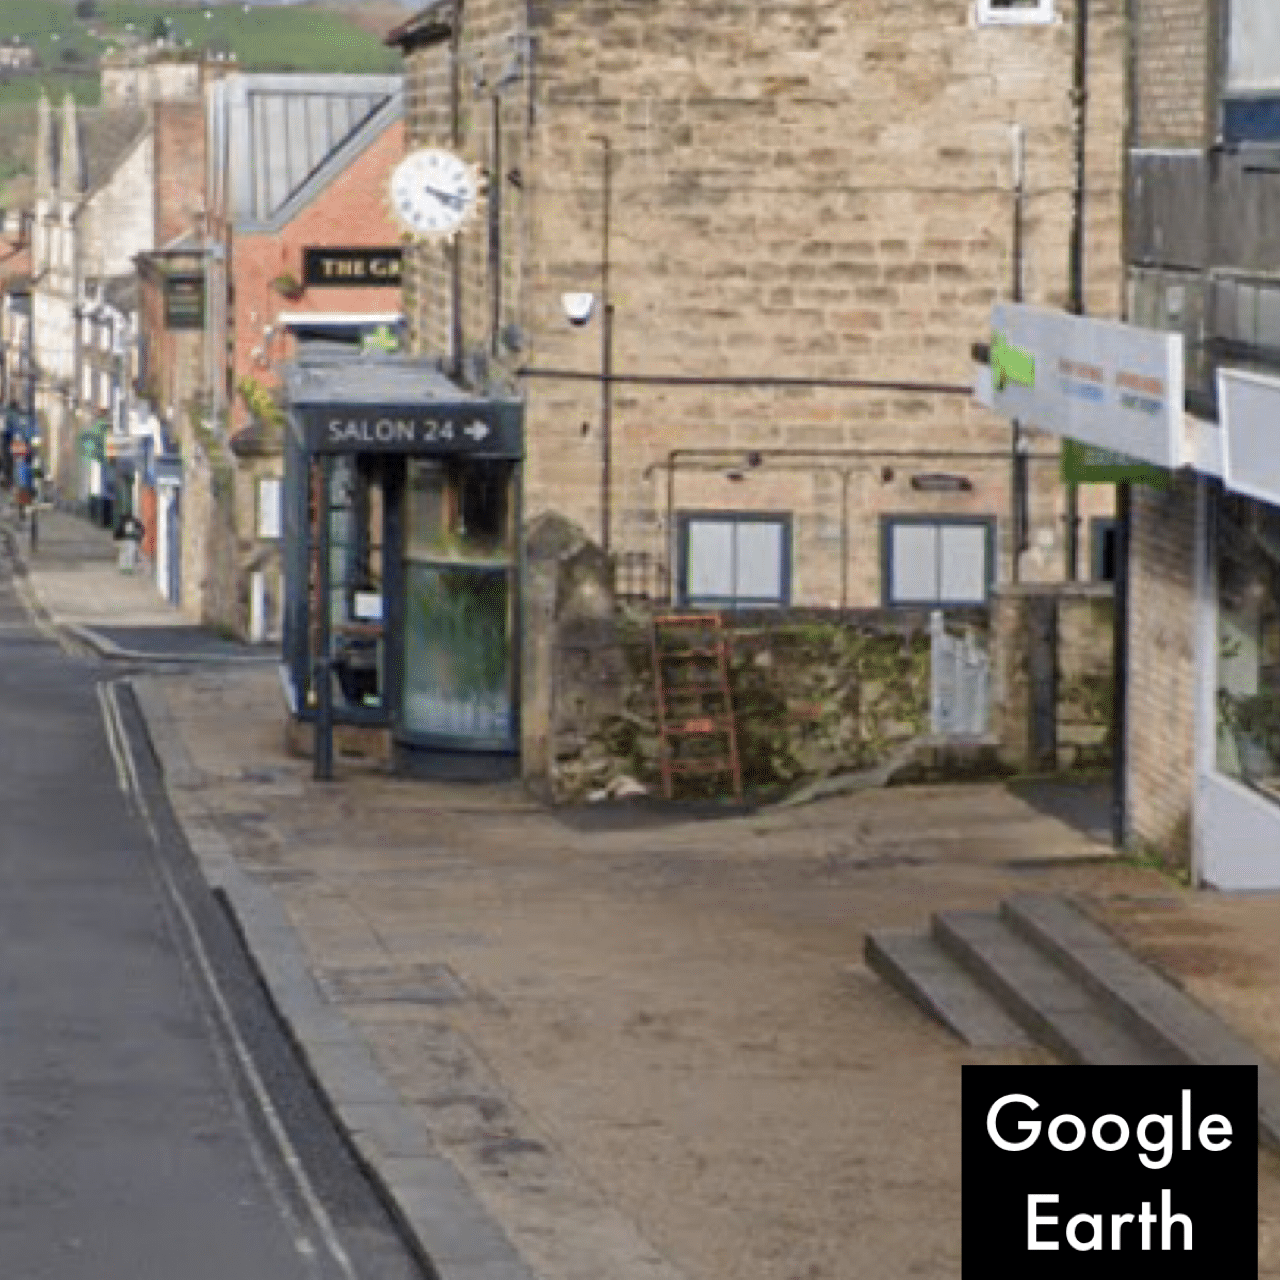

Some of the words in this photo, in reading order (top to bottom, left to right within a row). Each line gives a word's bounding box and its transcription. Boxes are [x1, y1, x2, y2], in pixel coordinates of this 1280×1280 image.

[320, 258, 365, 278] THE
[329, 419, 414, 441] SALON
[423, 419, 455, 441] 24
